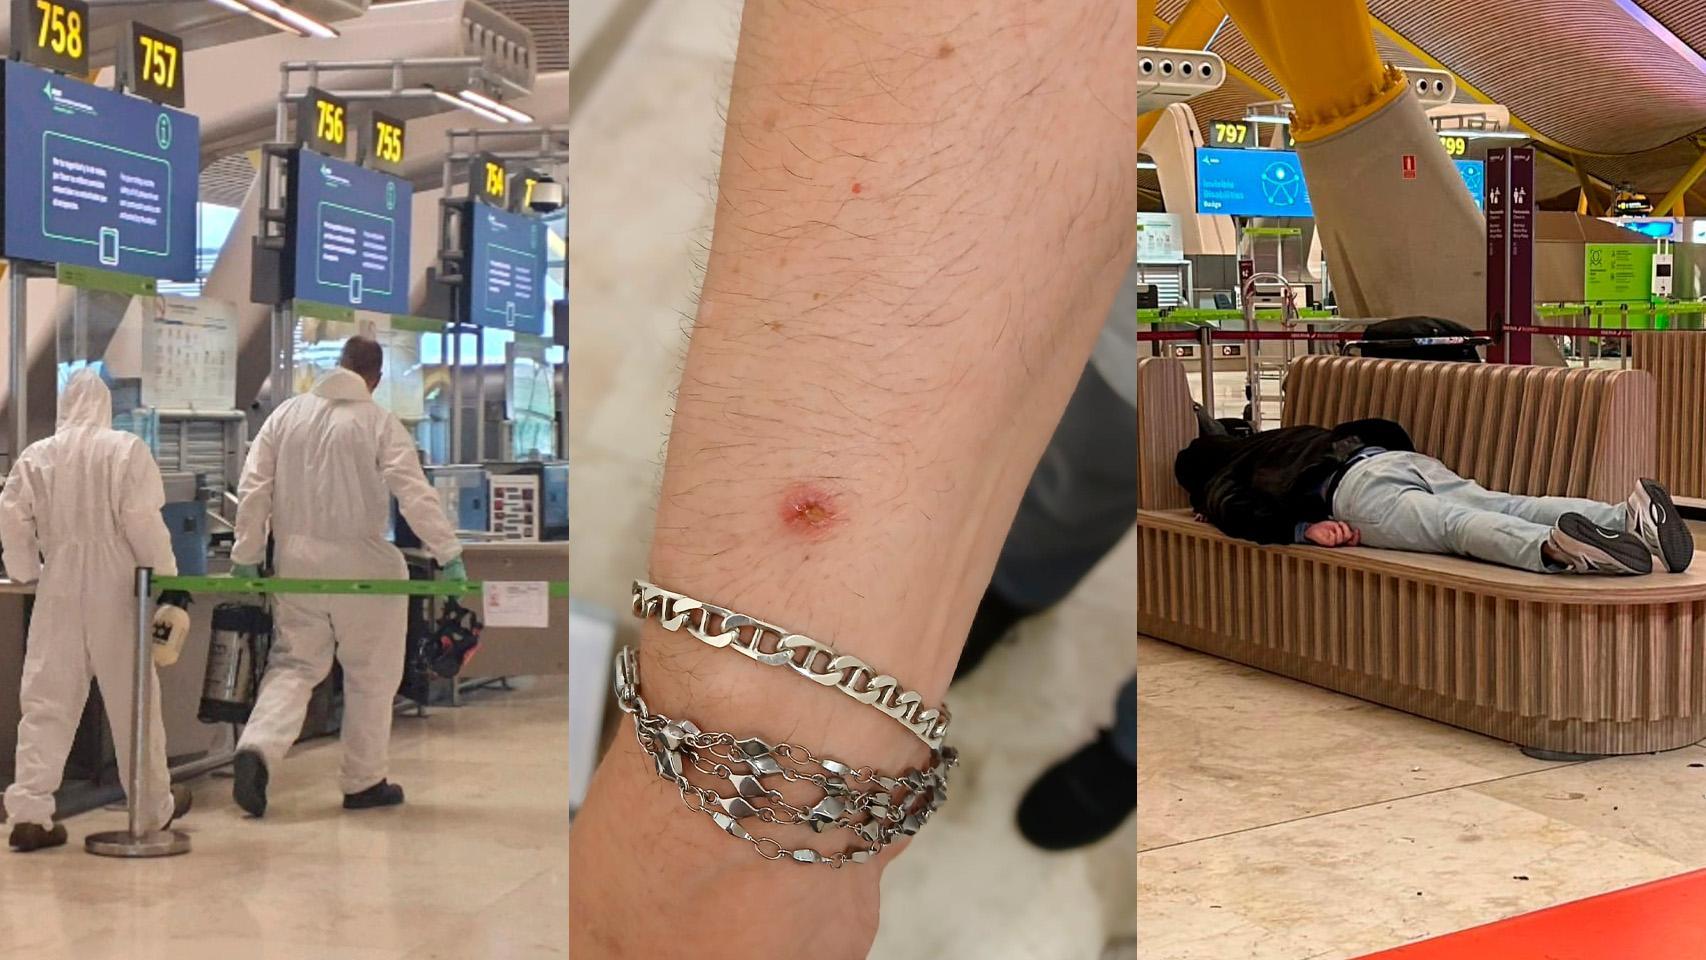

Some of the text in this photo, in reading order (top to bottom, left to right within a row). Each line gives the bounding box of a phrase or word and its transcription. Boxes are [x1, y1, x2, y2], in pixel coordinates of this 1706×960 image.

[37, 0, 82, 59] 758
[139, 35, 177, 88] 757
[316, 100, 344, 144] 756
[376, 121, 402, 162] 755
[1215, 124, 1246, 144] 797
[485, 162, 504, 196] 754
